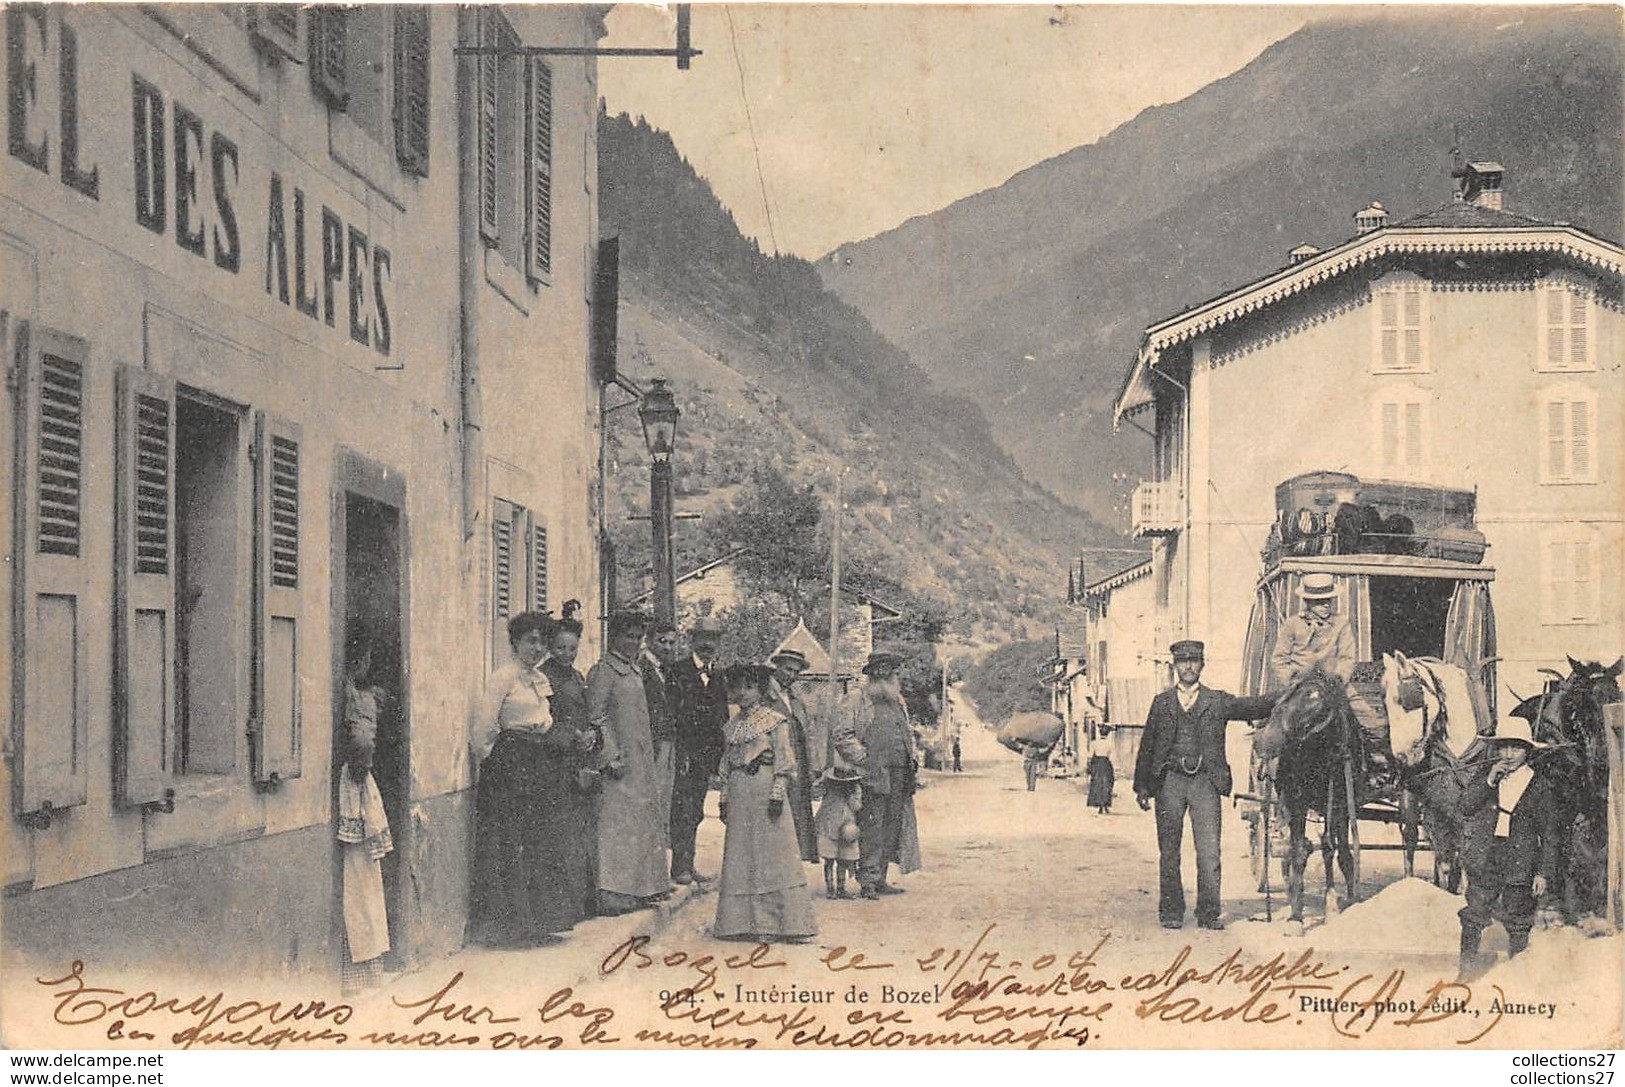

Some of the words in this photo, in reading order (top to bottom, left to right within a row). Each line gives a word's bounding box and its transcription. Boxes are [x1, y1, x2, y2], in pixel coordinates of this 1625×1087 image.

[132, 71, 241, 275] DES
[266, 170, 391, 357] ALPES
[601, 934, 786, 991] Bozel
